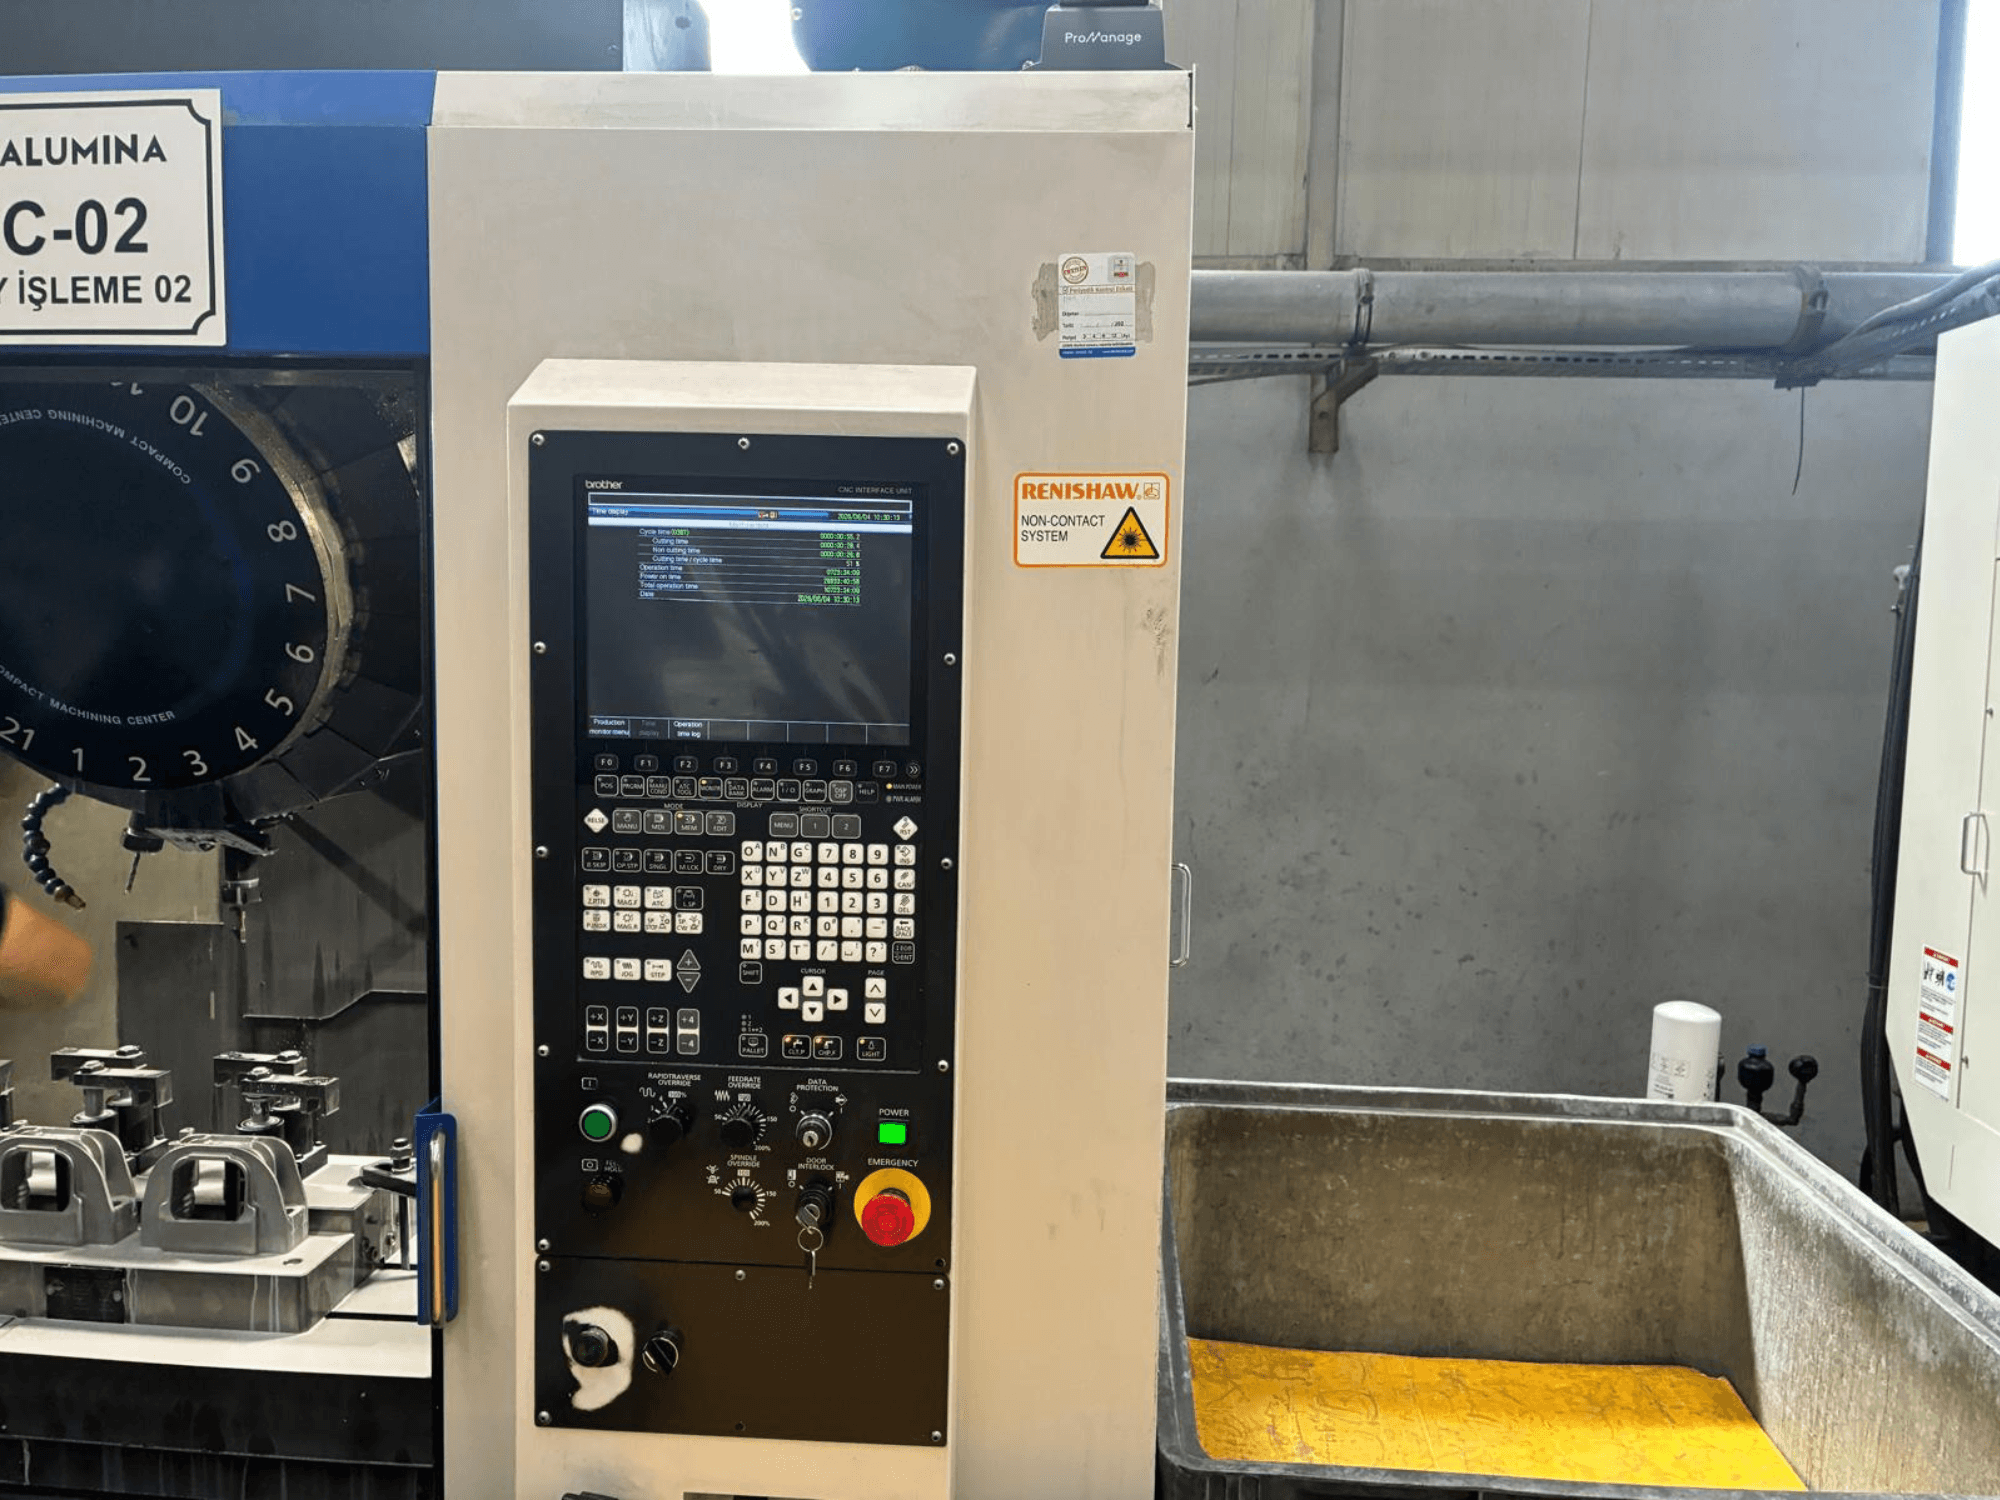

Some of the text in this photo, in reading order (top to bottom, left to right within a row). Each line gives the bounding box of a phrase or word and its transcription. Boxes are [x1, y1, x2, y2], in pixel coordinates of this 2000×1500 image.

[1065, 32, 1142, 46] ProManage
[0, 134, 167, 166] ALUMINA
[19, 269, 142, 311] İŞLEME
[155, 275, 192, 303] 02
[170, 395, 208, 437] 10
[0, 409, 191, 484] CENTE MACHINING COMPACT
[585, 480, 623, 489] brother
[1022, 482, 1139, 500] RENISHAW
[1021, 514, 1105, 527] NON-CONTACT
[267, 520, 297, 542] 8
[1021, 530, 1068, 542] SYSTEM
[285, 583, 316, 602] 7
[285, 643, 314, 663] 6
[264, 689, 294, 716] 5
[49, 698, 121, 725] MACHINING
[127, 710, 175, 725] CENTER
[0, 716, 36, 751] 21
[234, 726, 258, 752] 4
[72, 748, 83, 771] 1
[183, 751, 207, 776] 3
[129, 757, 150, 781] 2
[769, 847, 777, 856] N
[794, 848, 802, 857] G
[826, 849, 832, 858] 7
[850, 850, 856, 859] 8
[874, 850, 881, 859] 9
[745, 871, 753, 880] X
[769, 871, 776, 880] Y
[794, 872, 801, 881] Z
[825, 873, 832, 882] 4
[850, 874, 856, 882] 5
[874, 874, 881, 883] 6
[745, 895, 751, 905] F
[769, 896, 777, 905] D
[793, 897, 801, 906] H
[825, 898, 830, 907] 1
[849, 898, 855, 908] 2
[874, 899, 880, 908] 3
[745, 920, 752, 929] P
[768, 921, 777, 930] Q
[794, 921, 801, 930] R
[743, 944, 753, 953] M
[769, 945, 775, 954] S
[793, 945, 800, 955] T
[797, 1084, 838, 1092] PROTECTION
[879, 1109, 909, 1117] POWER
[868, 1159, 919, 1167] EMERGENCY
